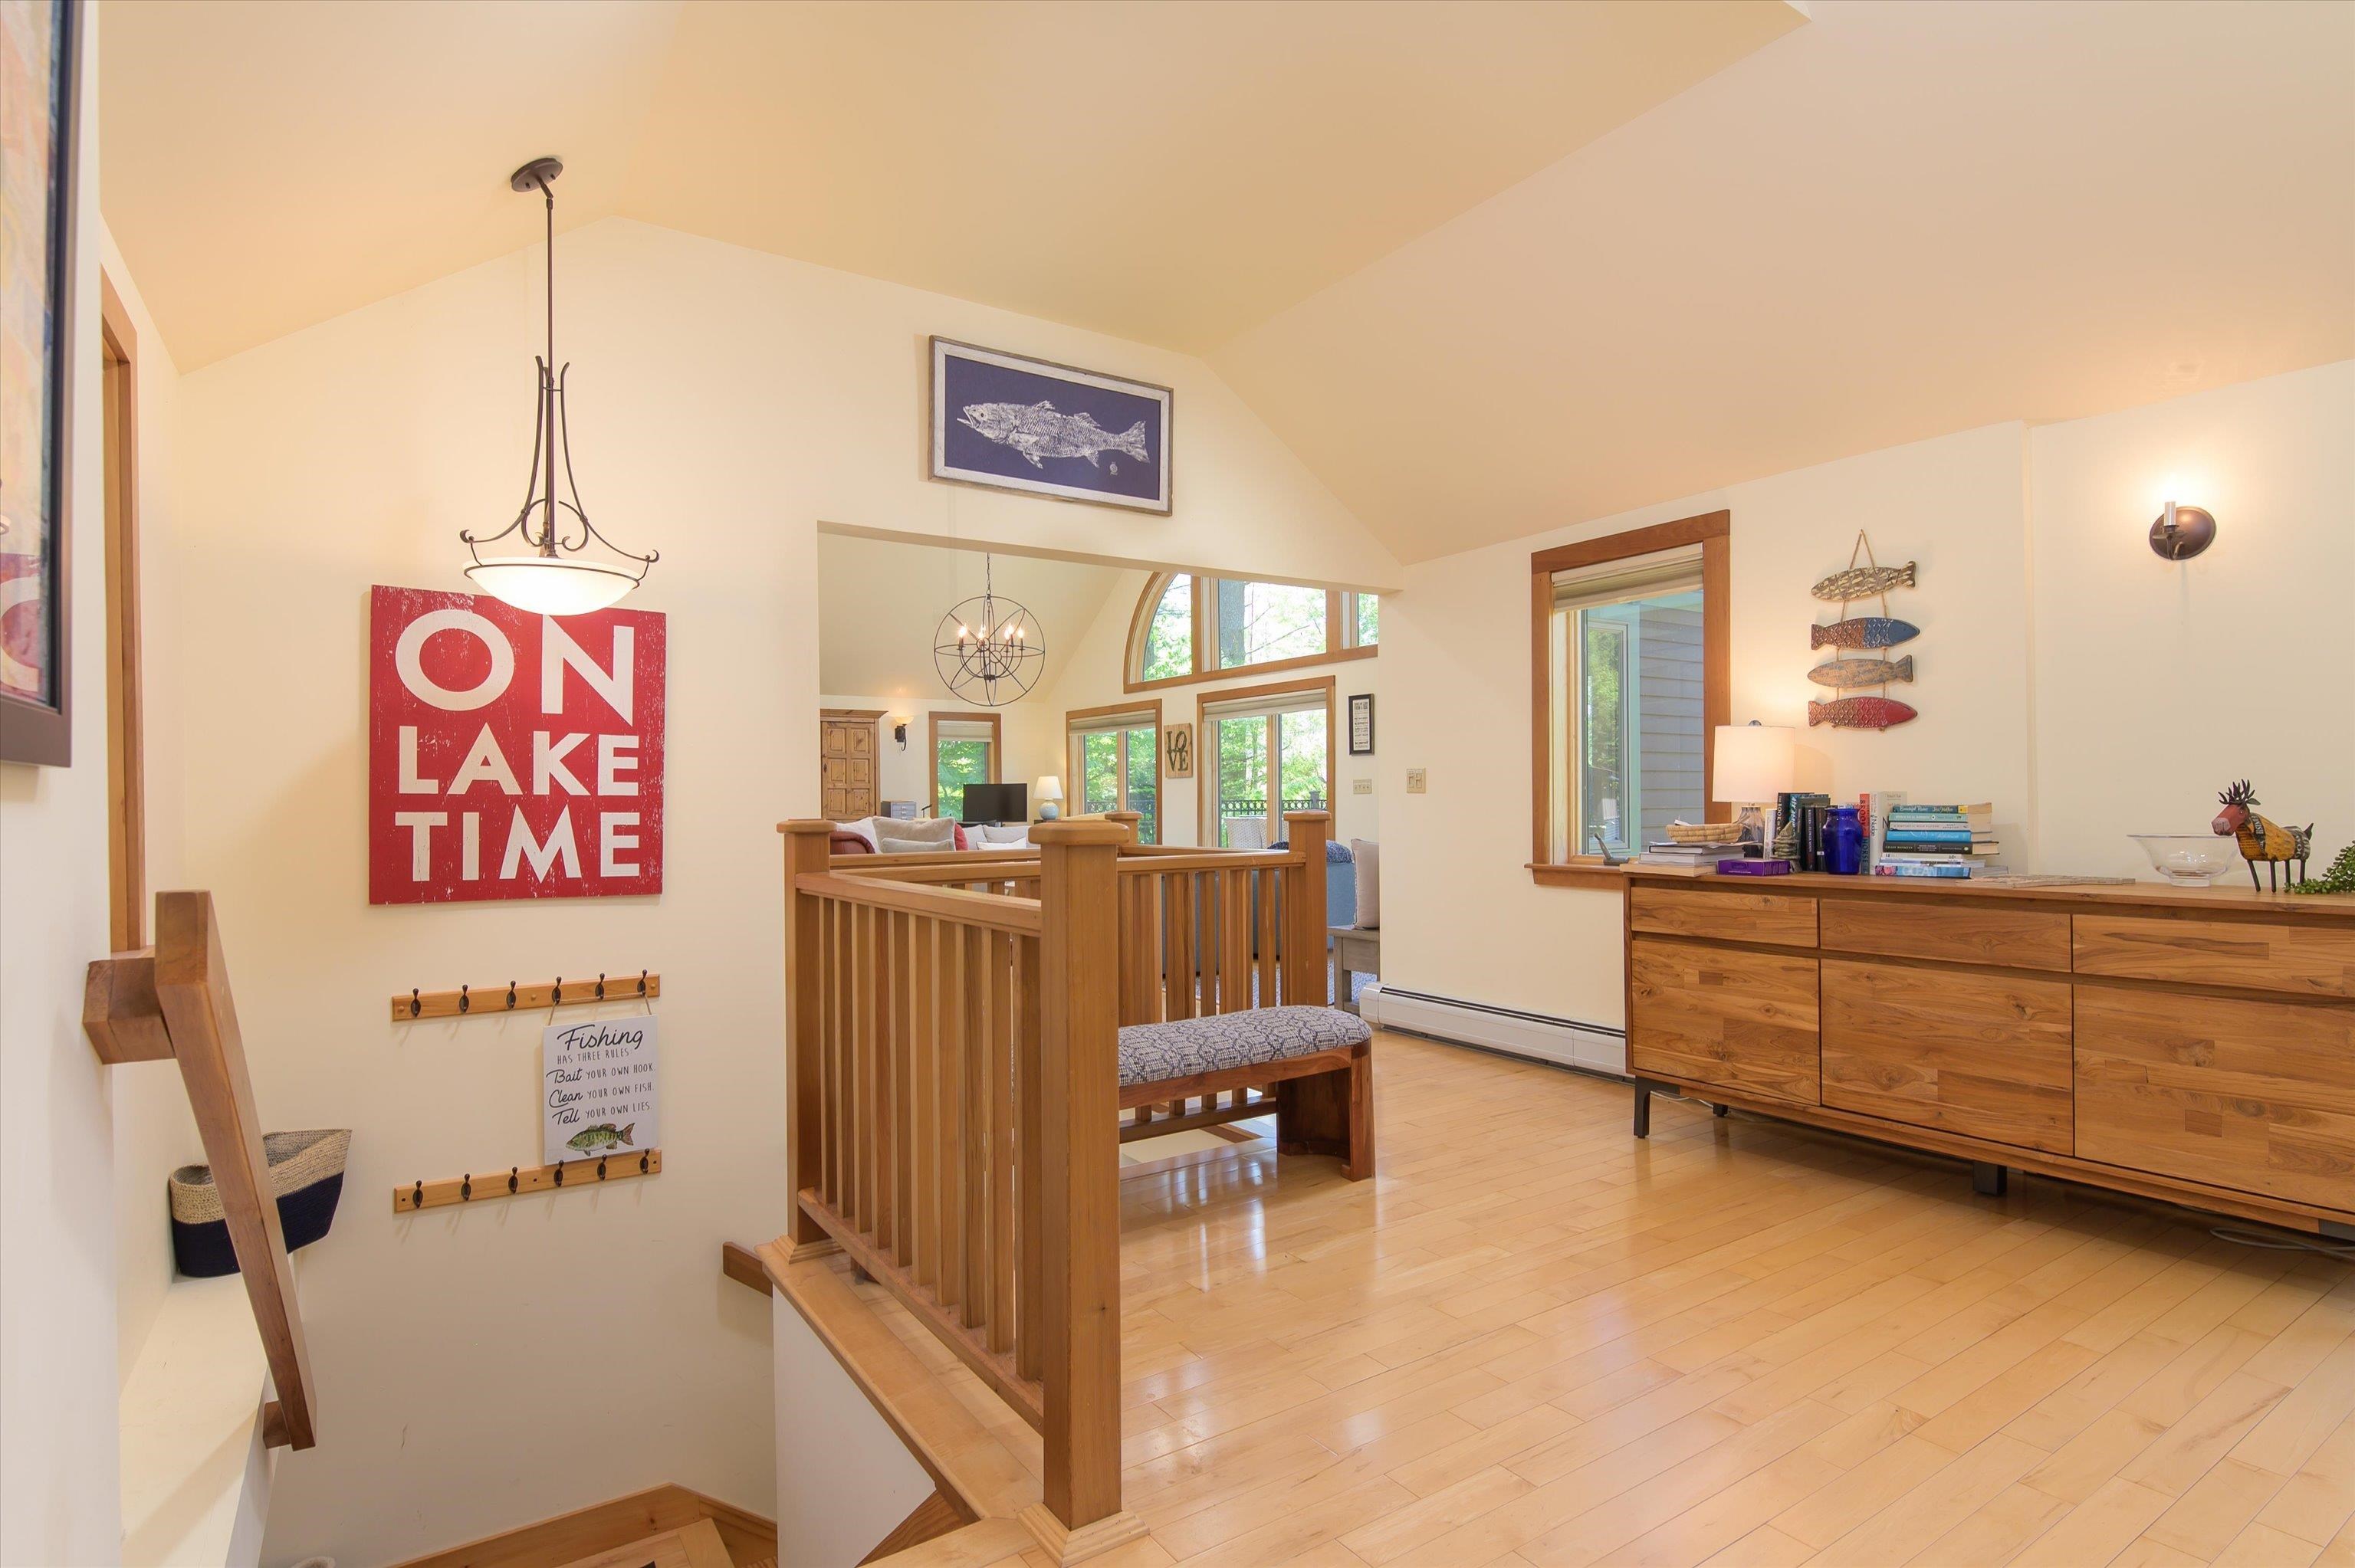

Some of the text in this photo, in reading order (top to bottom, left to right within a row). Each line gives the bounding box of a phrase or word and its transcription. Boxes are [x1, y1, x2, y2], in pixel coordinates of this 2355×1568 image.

[395, 609, 635, 727] ON
[399, 722, 639, 796] LAKE
[395, 803, 640, 884] TIME
[557, 1024, 644, 1051] Fishing
[557, 1055, 573, 1064] HAS
[578, 1051, 601, 1062] THREE
[546, 1068, 583, 1084] Bait
[586, 1068, 606, 1080] YOUR
[611, 1065, 629, 1076] OWN
[548, 1081, 654, 1108] Clean YOUR OWN FISH.
[552, 1102, 652, 1125] Tell YOUR OWN LIES.
